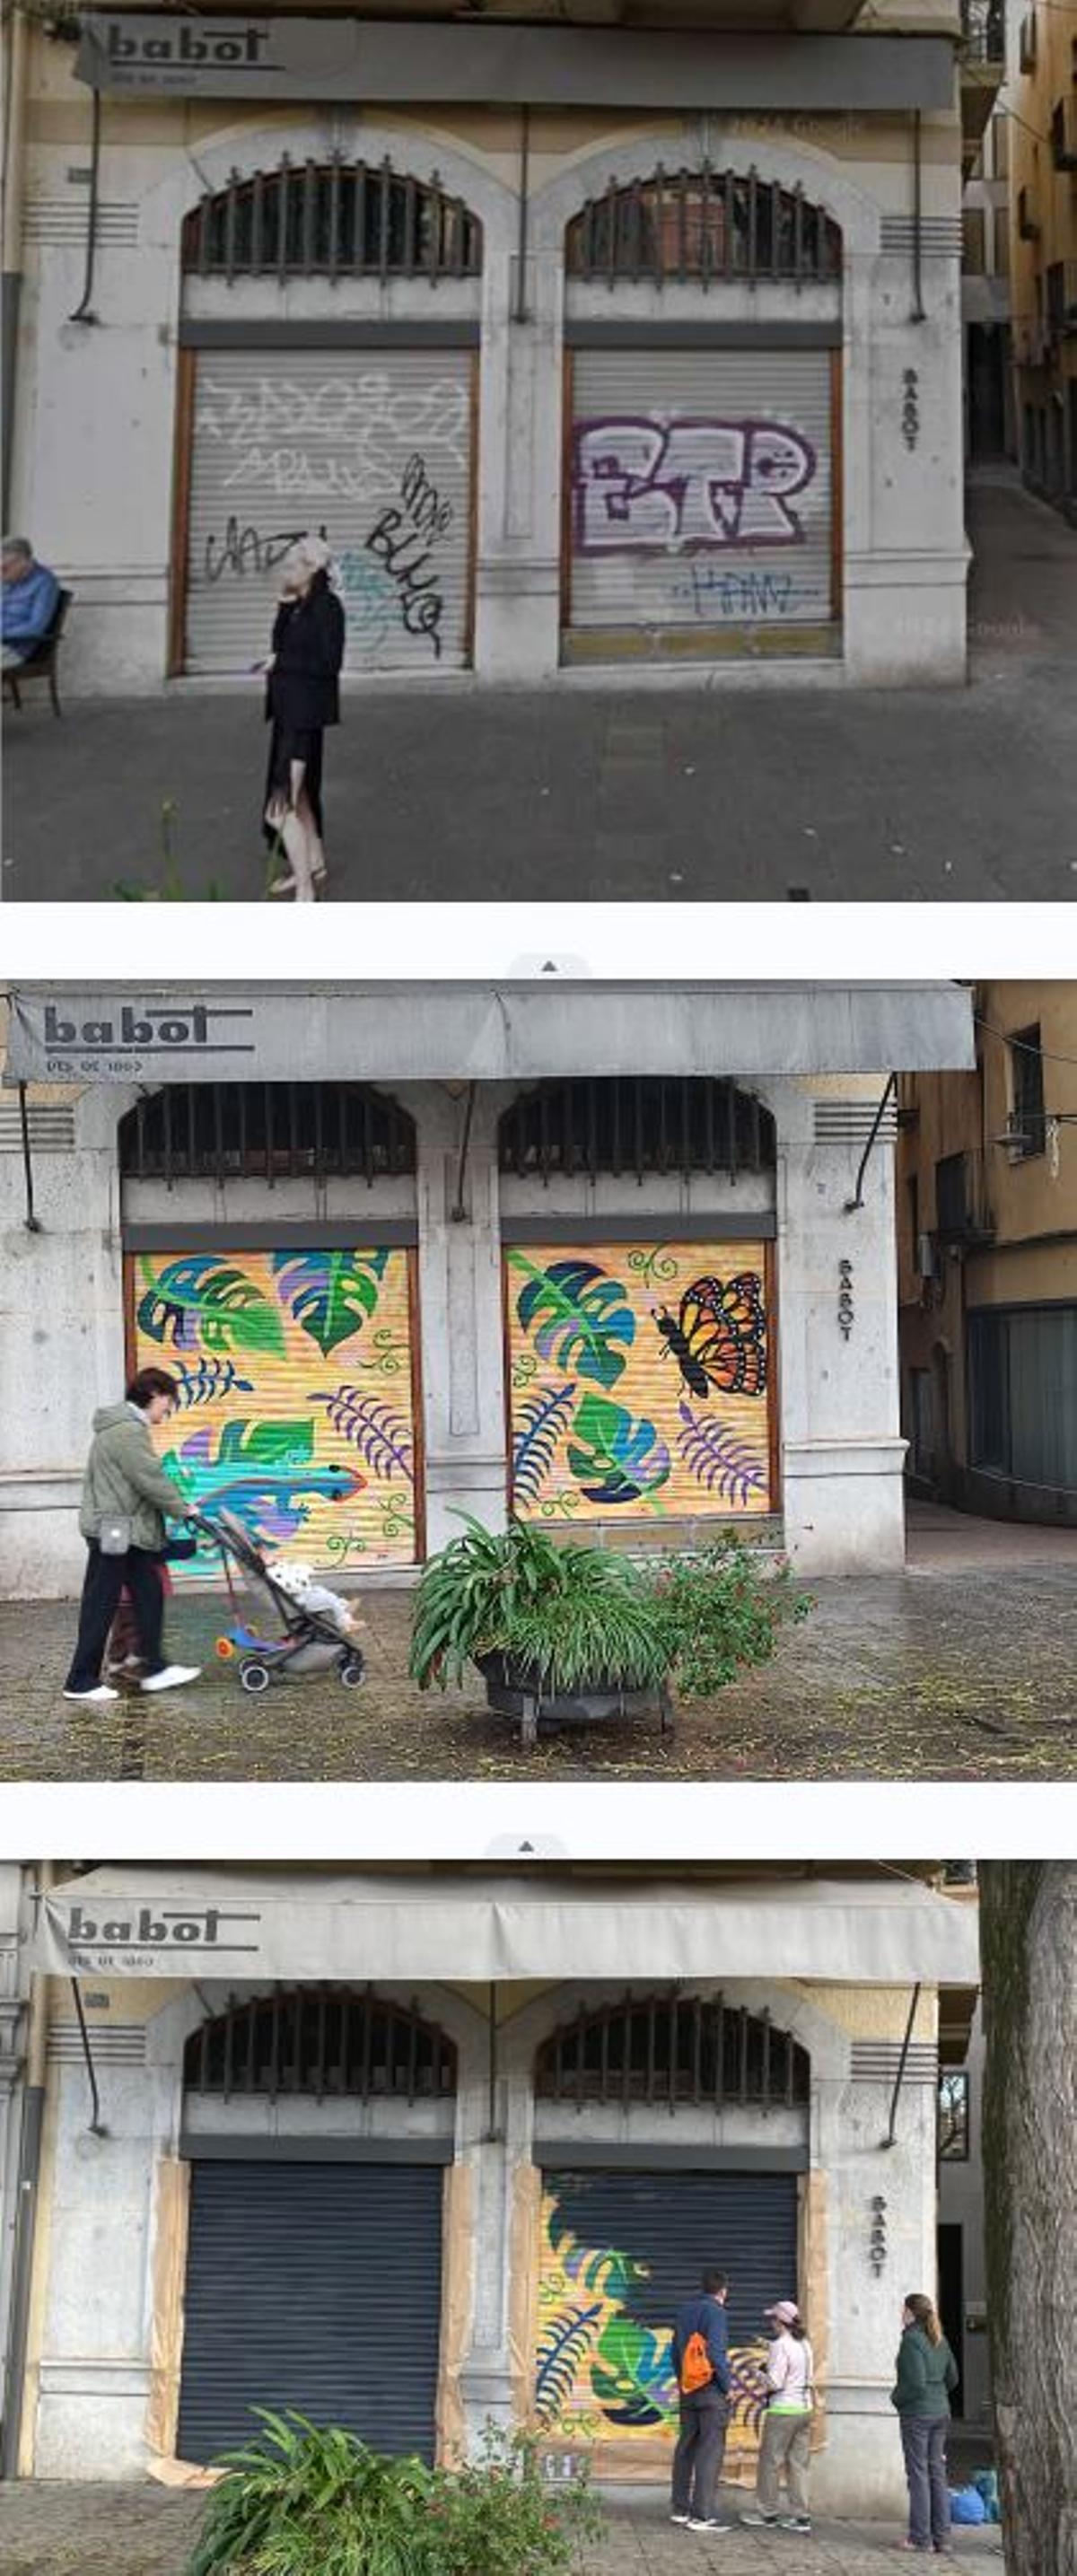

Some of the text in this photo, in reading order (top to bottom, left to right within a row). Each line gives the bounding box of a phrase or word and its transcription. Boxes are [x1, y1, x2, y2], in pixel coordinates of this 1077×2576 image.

[108, 25, 268, 62] babot
[901, 367, 920, 451] BABOT
[44, 1004, 253, 1044] babot
[837, 1258, 854, 1341] BABOT
[67, 1907, 261, 1942] babot
[869, 2195, 888, 2278] BABOT
